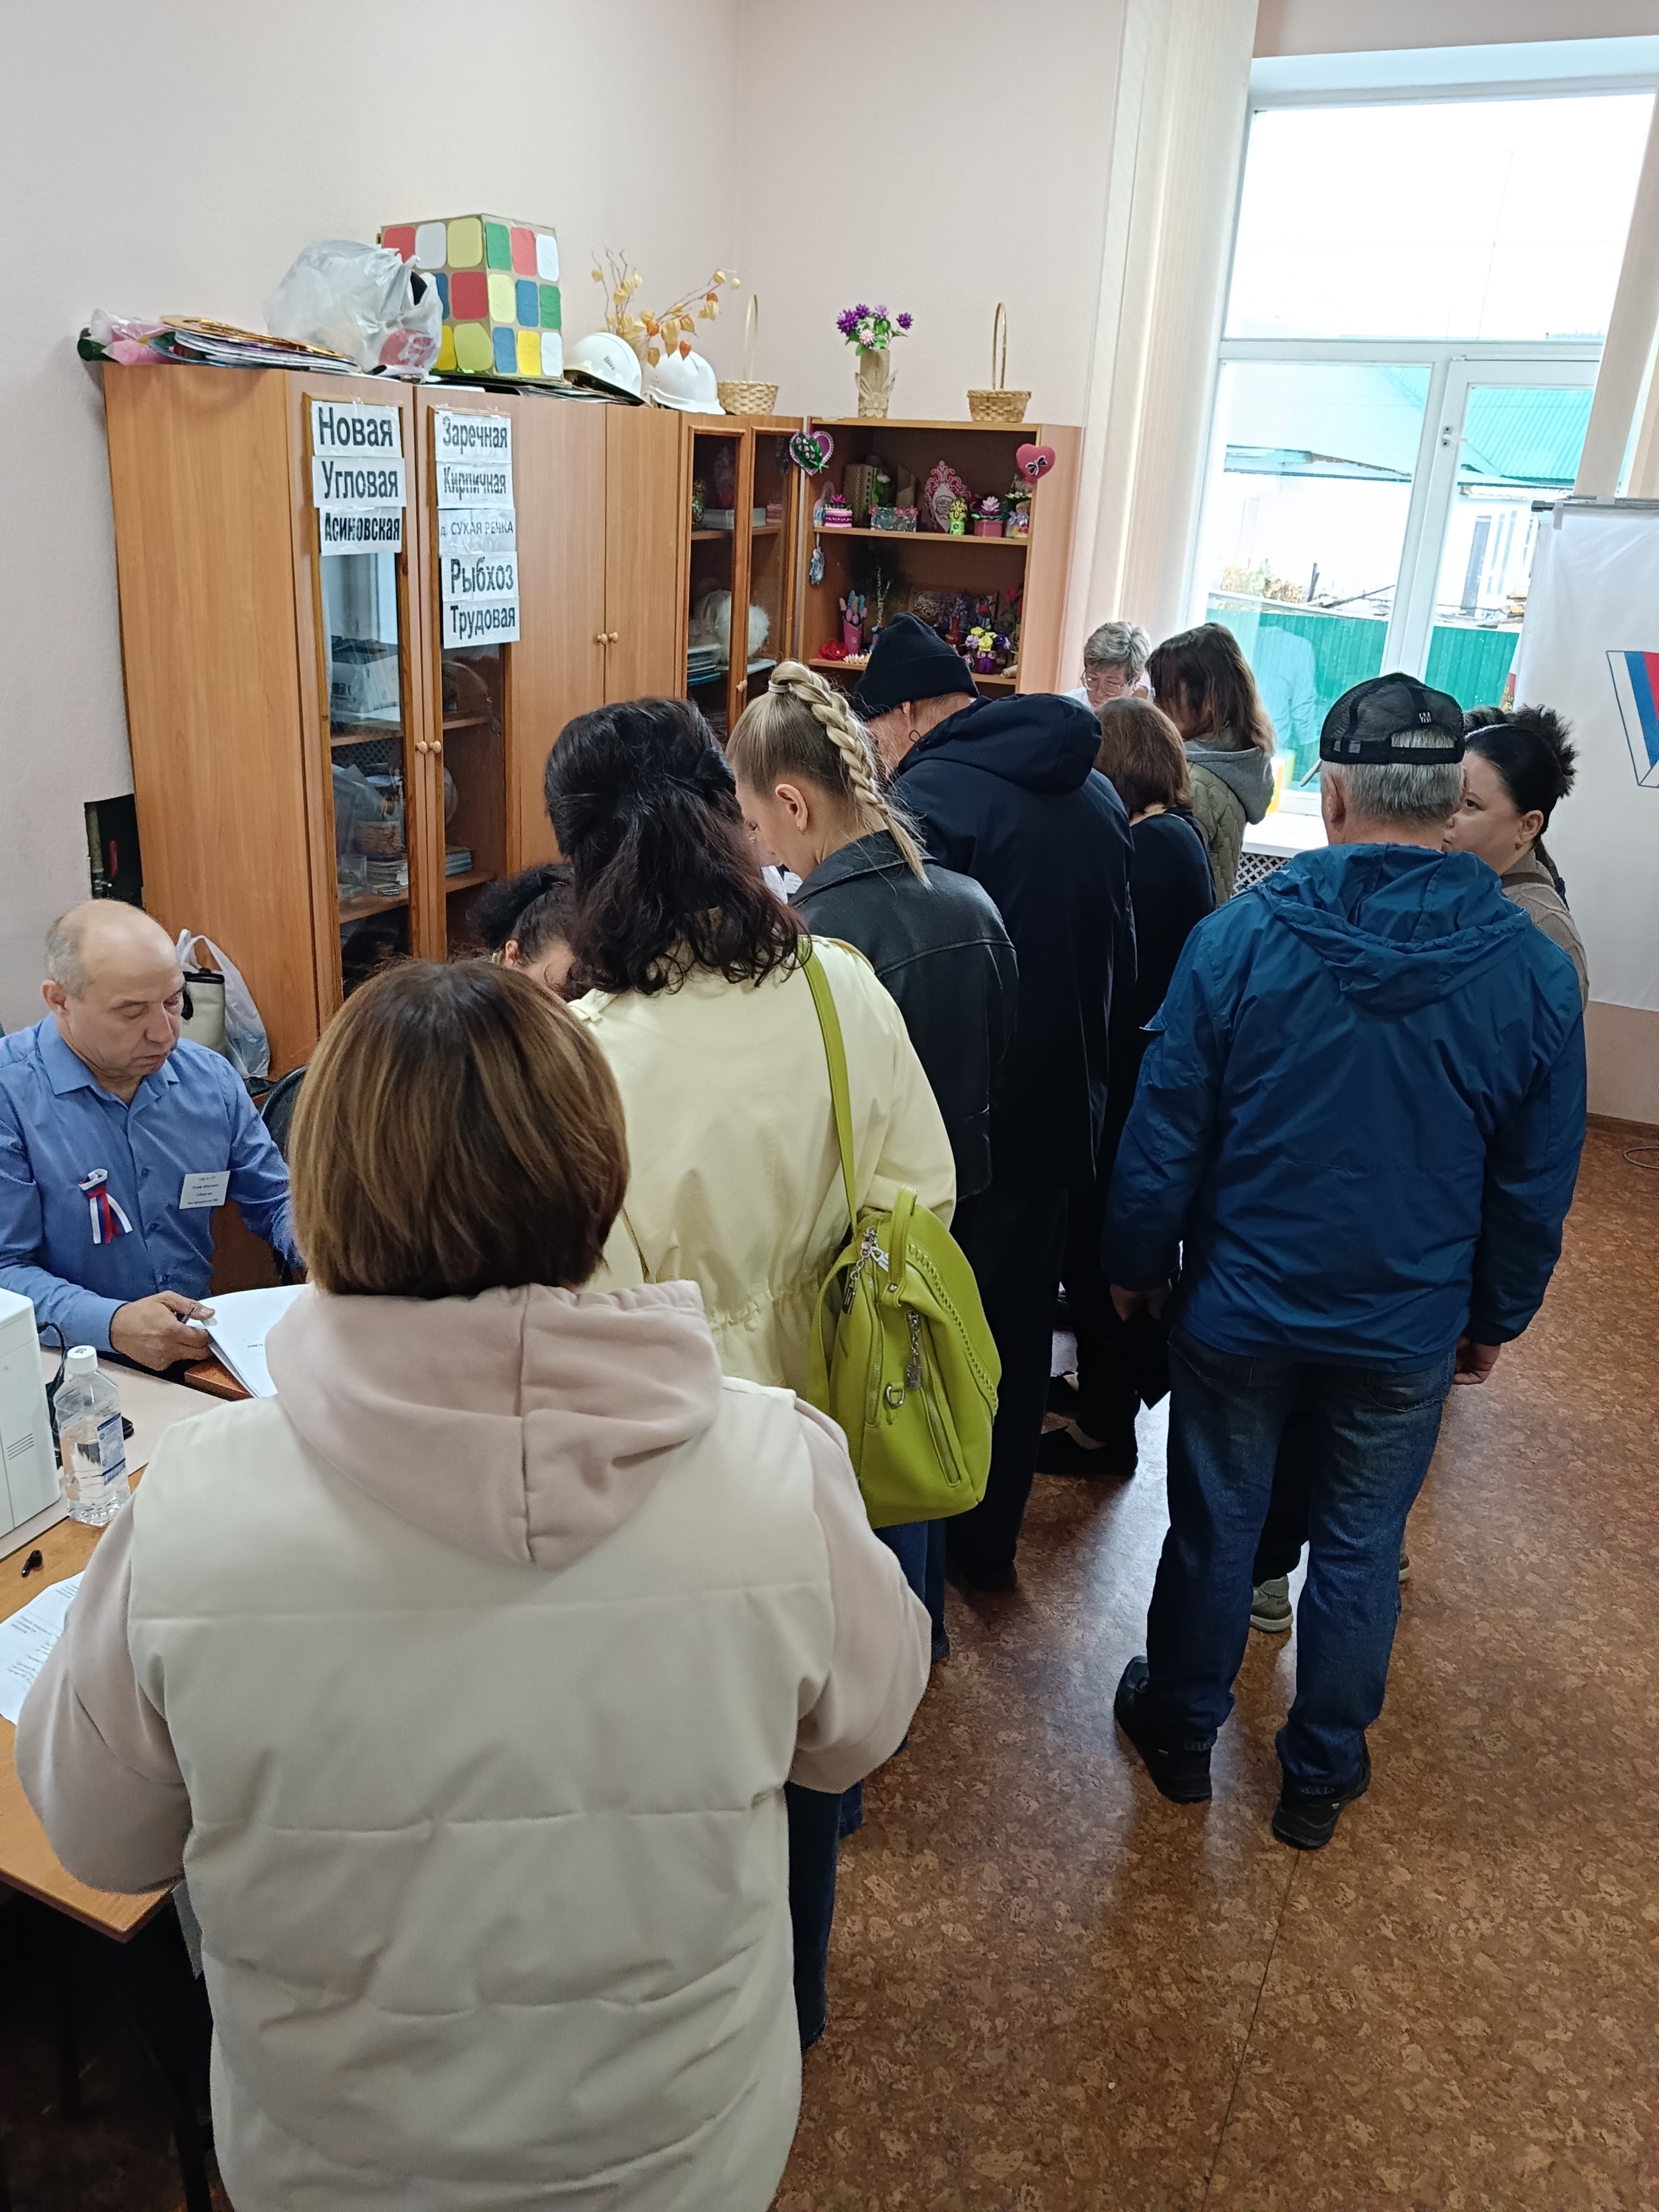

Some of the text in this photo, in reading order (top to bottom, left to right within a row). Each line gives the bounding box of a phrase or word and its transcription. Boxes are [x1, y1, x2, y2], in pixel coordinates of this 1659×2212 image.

[319, 407, 393, 447] Новая
[442, 417, 508, 454] Заречная
[321, 461, 399, 499] Угловая
[444, 466, 507, 500] Кирпичная
[325, 512, 400, 541] Асиновская
[451, 521, 482, 535] СУХАЯ
[485, 521, 514, 535] РЕЧКА
[451, 556, 514, 594] Рыбхоз
[450, 605, 515, 639] Трудовая
